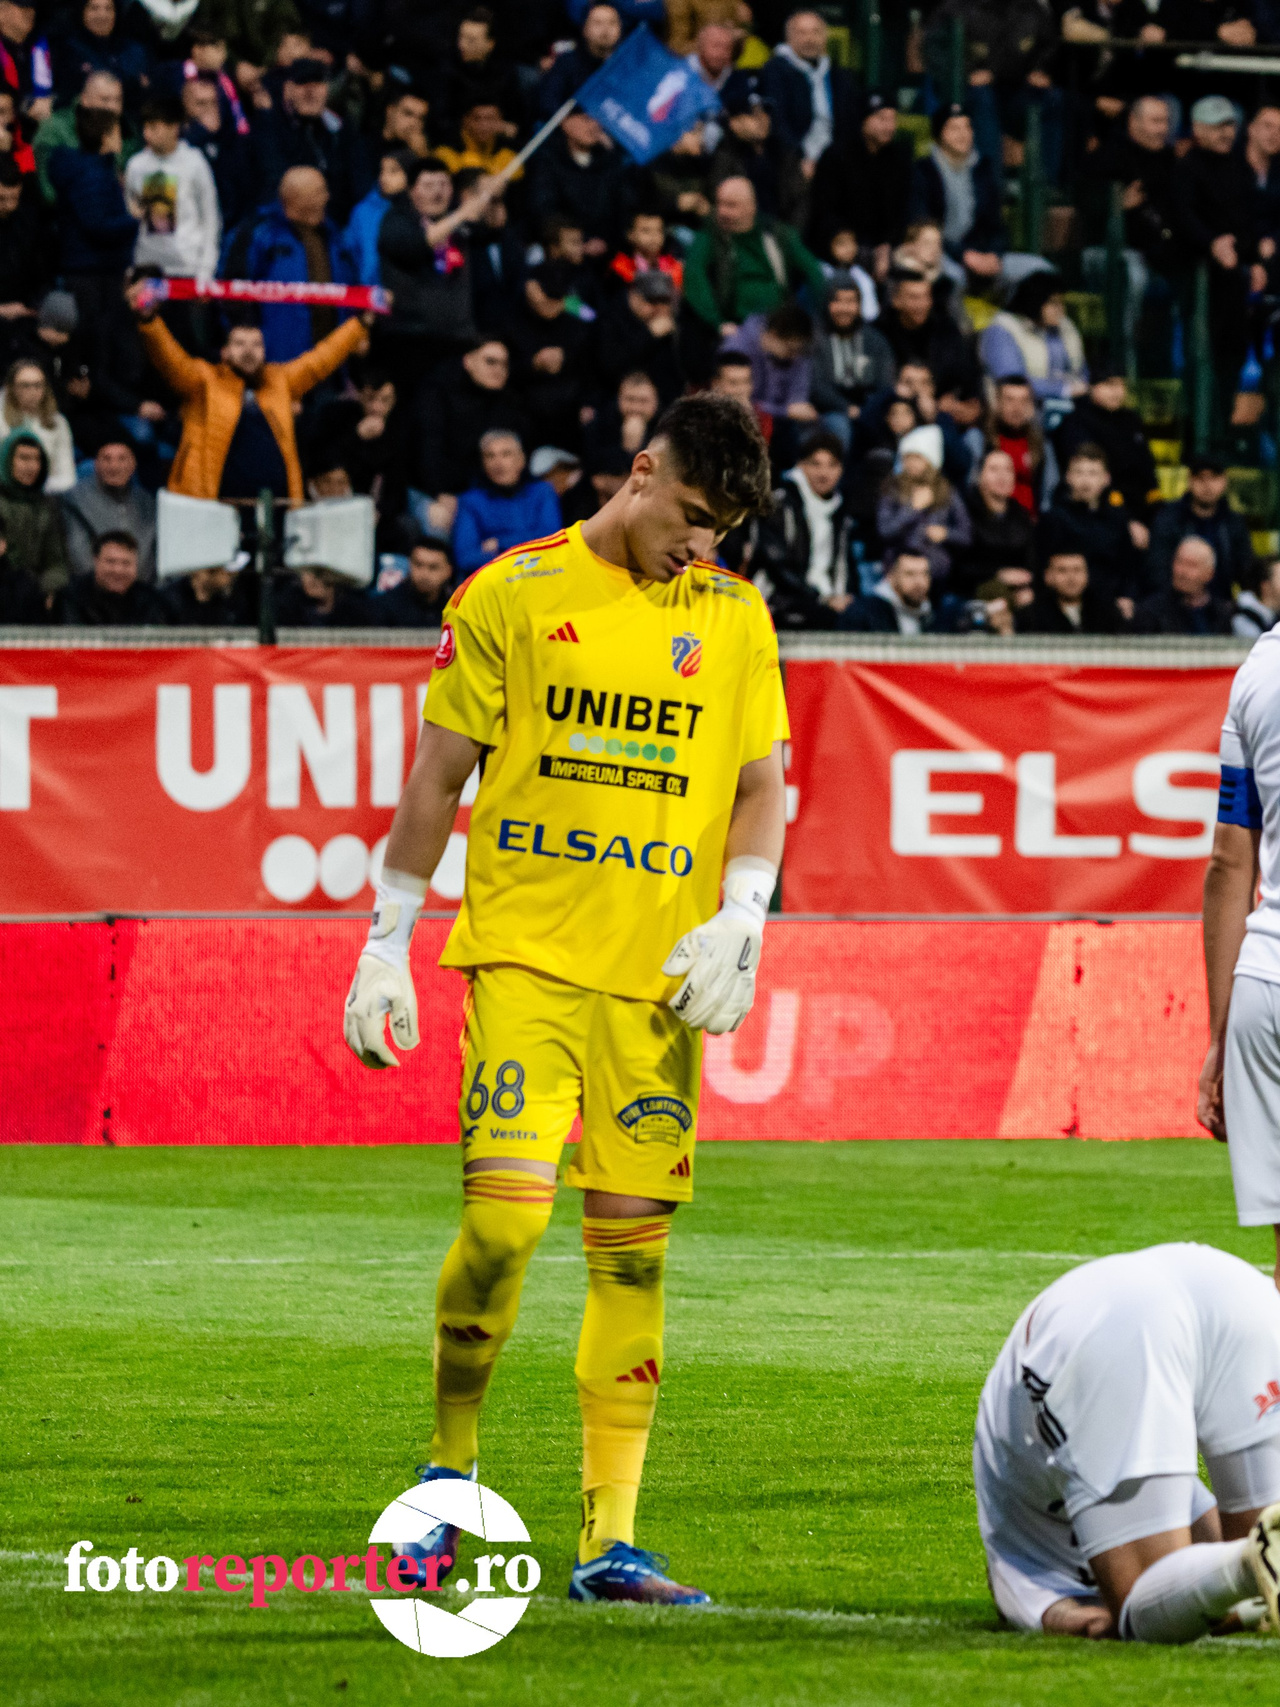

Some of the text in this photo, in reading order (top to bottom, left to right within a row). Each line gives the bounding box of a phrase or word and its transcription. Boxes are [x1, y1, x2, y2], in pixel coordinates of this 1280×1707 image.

[546, 685, 704, 739] UNIBET
[156, 683, 430, 813] UNI
[626, 771, 664, 791] SPRE
[665, 777, 682, 796] 0%
[498, 818, 693, 877] ELSACO
[467, 1060, 525, 1121] 68
[490, 1127, 538, 1140] Vestra
